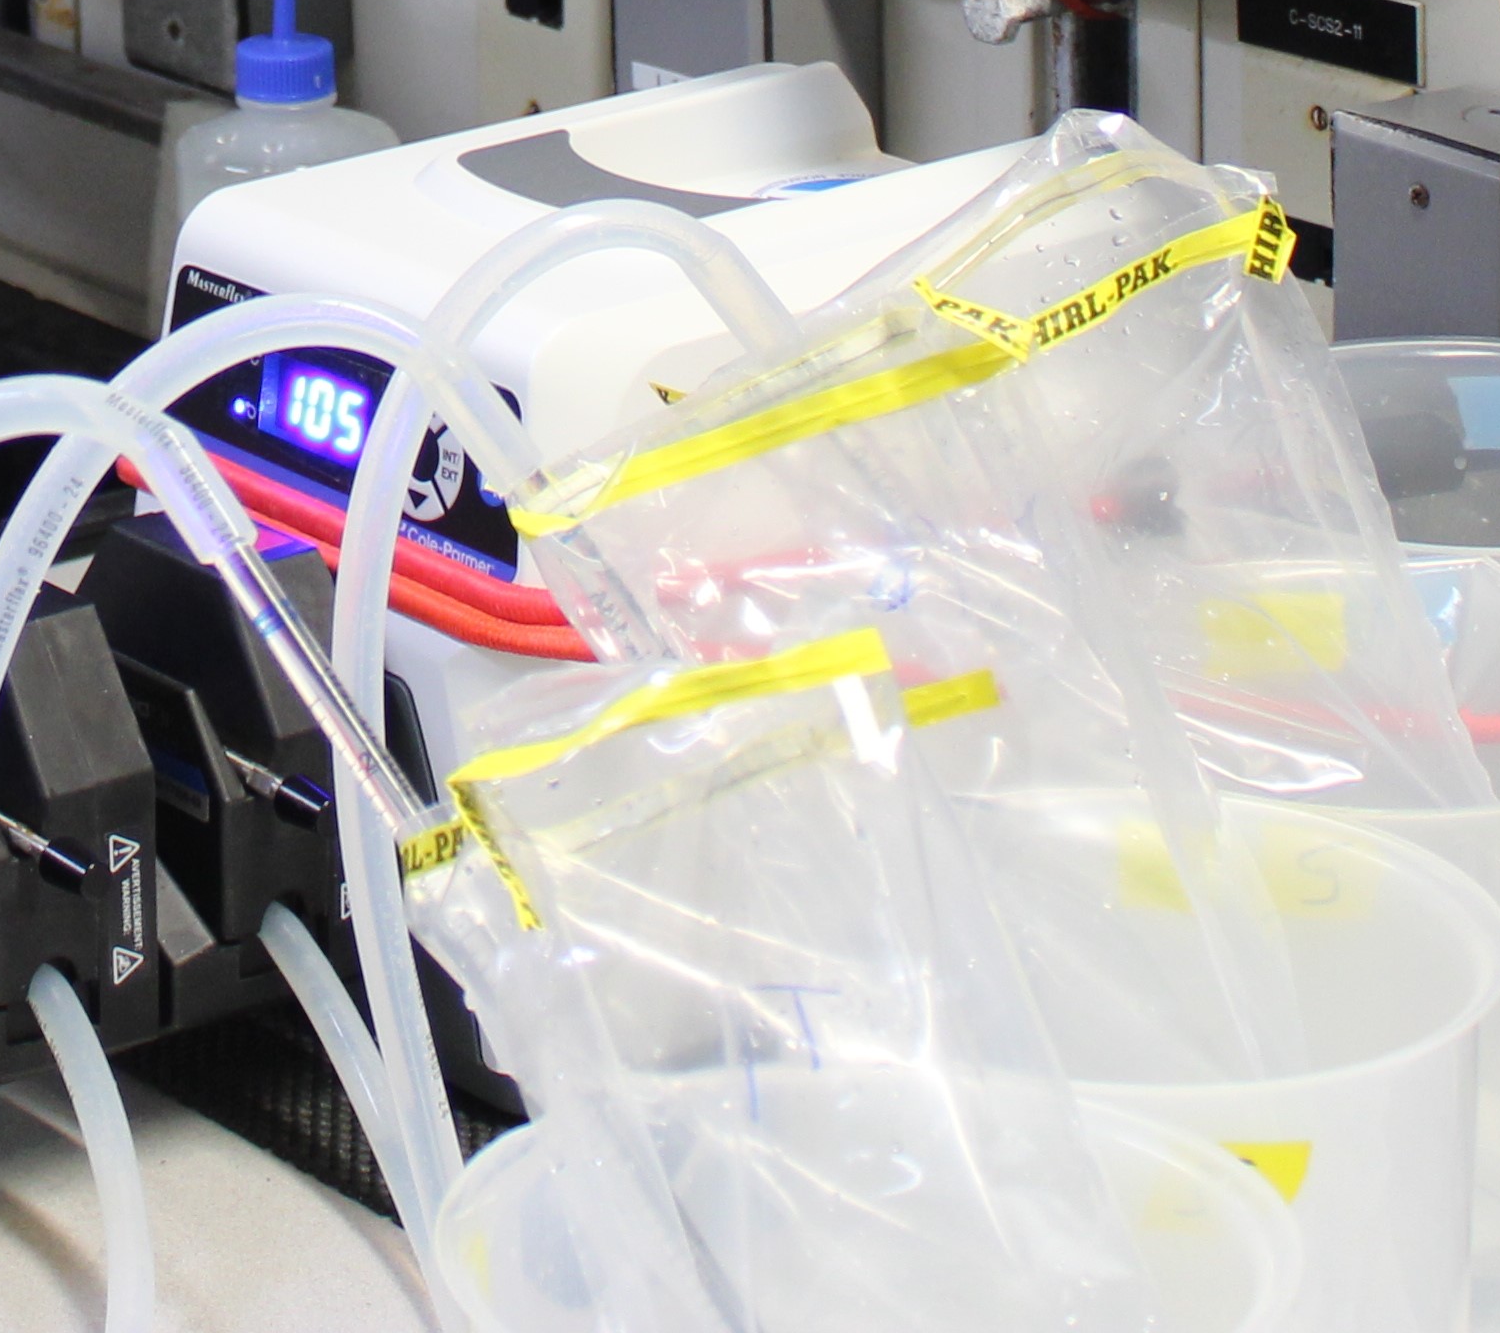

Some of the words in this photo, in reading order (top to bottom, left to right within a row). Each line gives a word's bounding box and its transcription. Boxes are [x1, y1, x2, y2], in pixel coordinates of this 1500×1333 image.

[1289, 8, 1363, 40] C-SCS2-11
[290, 375, 365, 454] 105
[440, 469, 460, 483] EXT
[441, 450, 461, 466] INT/
[28, 509, 64, 559] 96400
[63, 477, 85, 499] 24
[407, 525, 494, 578] Cole-Parmer
[120, 877, 134, 937] WARNING:
[131, 857, 145, 951] AVERTISSEMENT:
